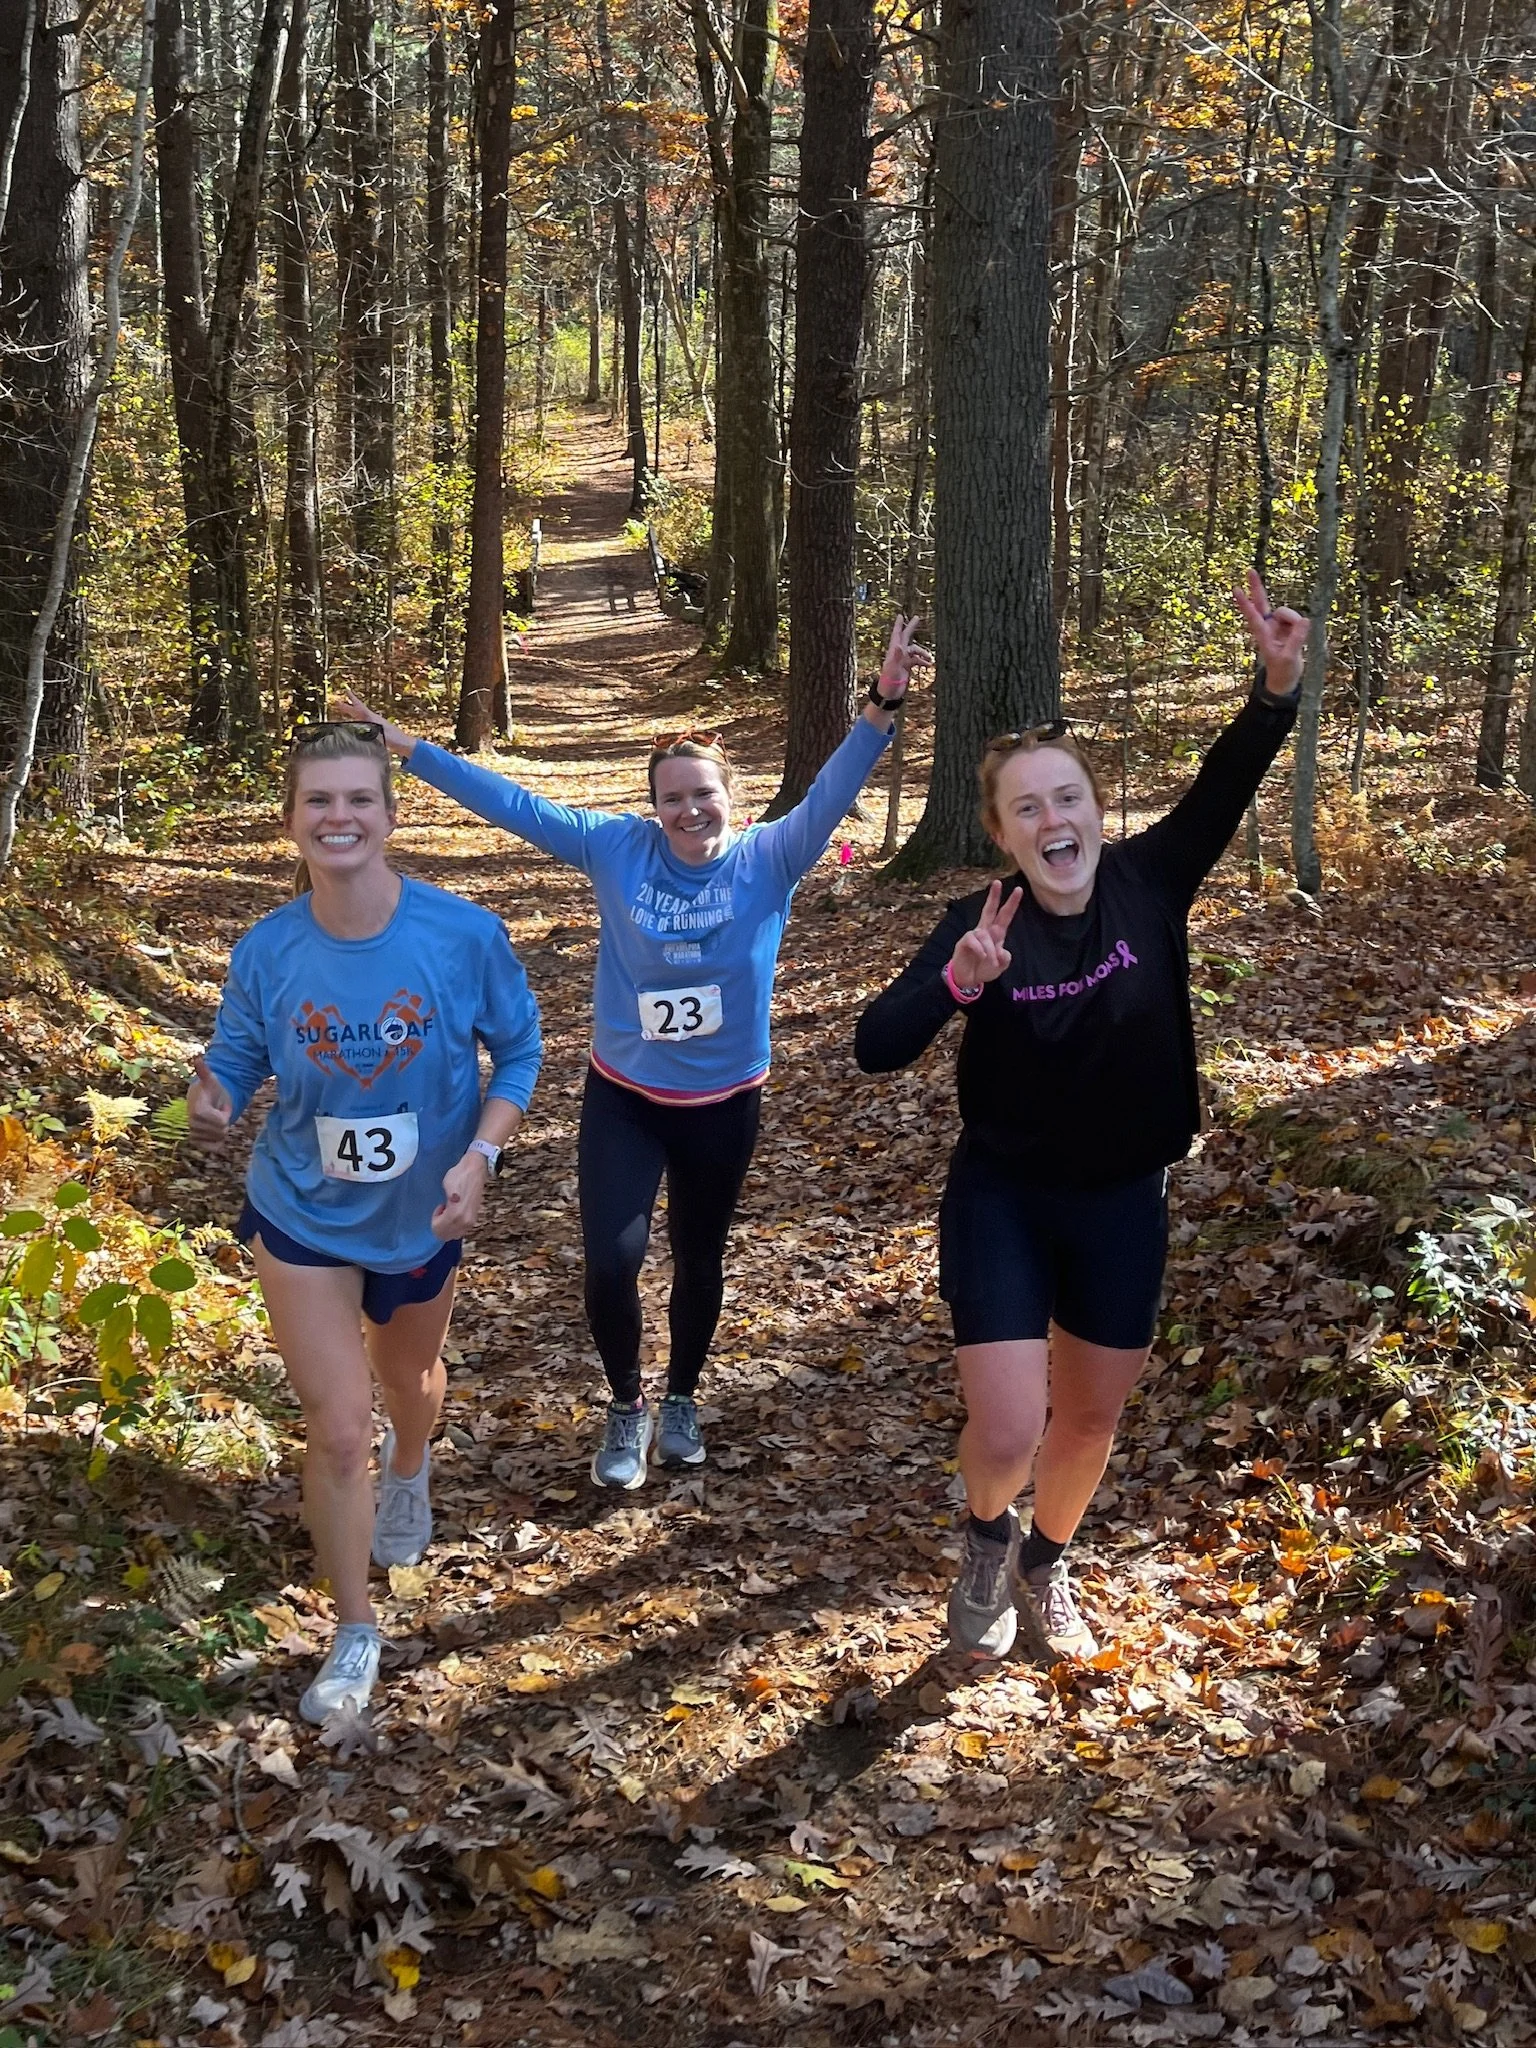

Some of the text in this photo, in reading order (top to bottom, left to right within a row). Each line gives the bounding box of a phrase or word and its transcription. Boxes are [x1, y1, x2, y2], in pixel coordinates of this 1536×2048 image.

[636, 883, 654, 905] 20
[713, 887, 732, 902] THE
[631, 905, 723, 932] LOVE OF RUNNING
[1012, 984, 1056, 1001] MILES
[653, 996, 703, 1034] 23
[337, 1127, 396, 1172] 43
